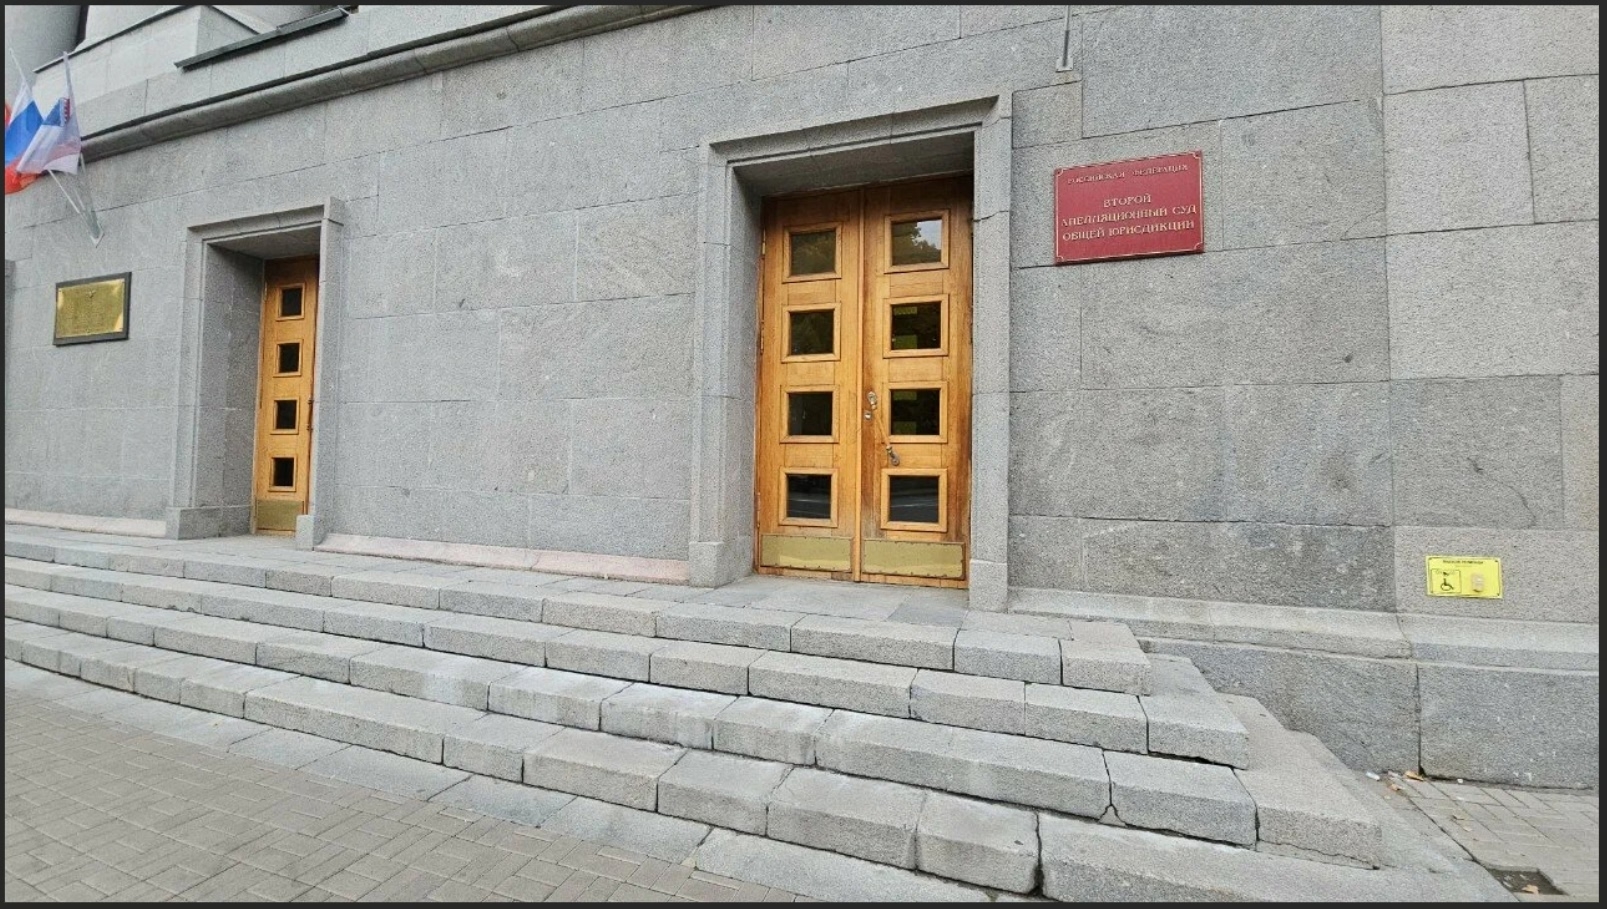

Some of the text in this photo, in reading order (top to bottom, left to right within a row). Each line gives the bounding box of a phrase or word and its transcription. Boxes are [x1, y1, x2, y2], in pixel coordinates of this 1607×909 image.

[1103, 193, 1151, 208] ВТОРОЙ
[1061, 204, 1197, 227] АПЕЛЛЯЦИОННЫЙ СУД
[1062, 220, 1195, 242] ОБЩЕЙ ЮРИСДИКЦИИ
